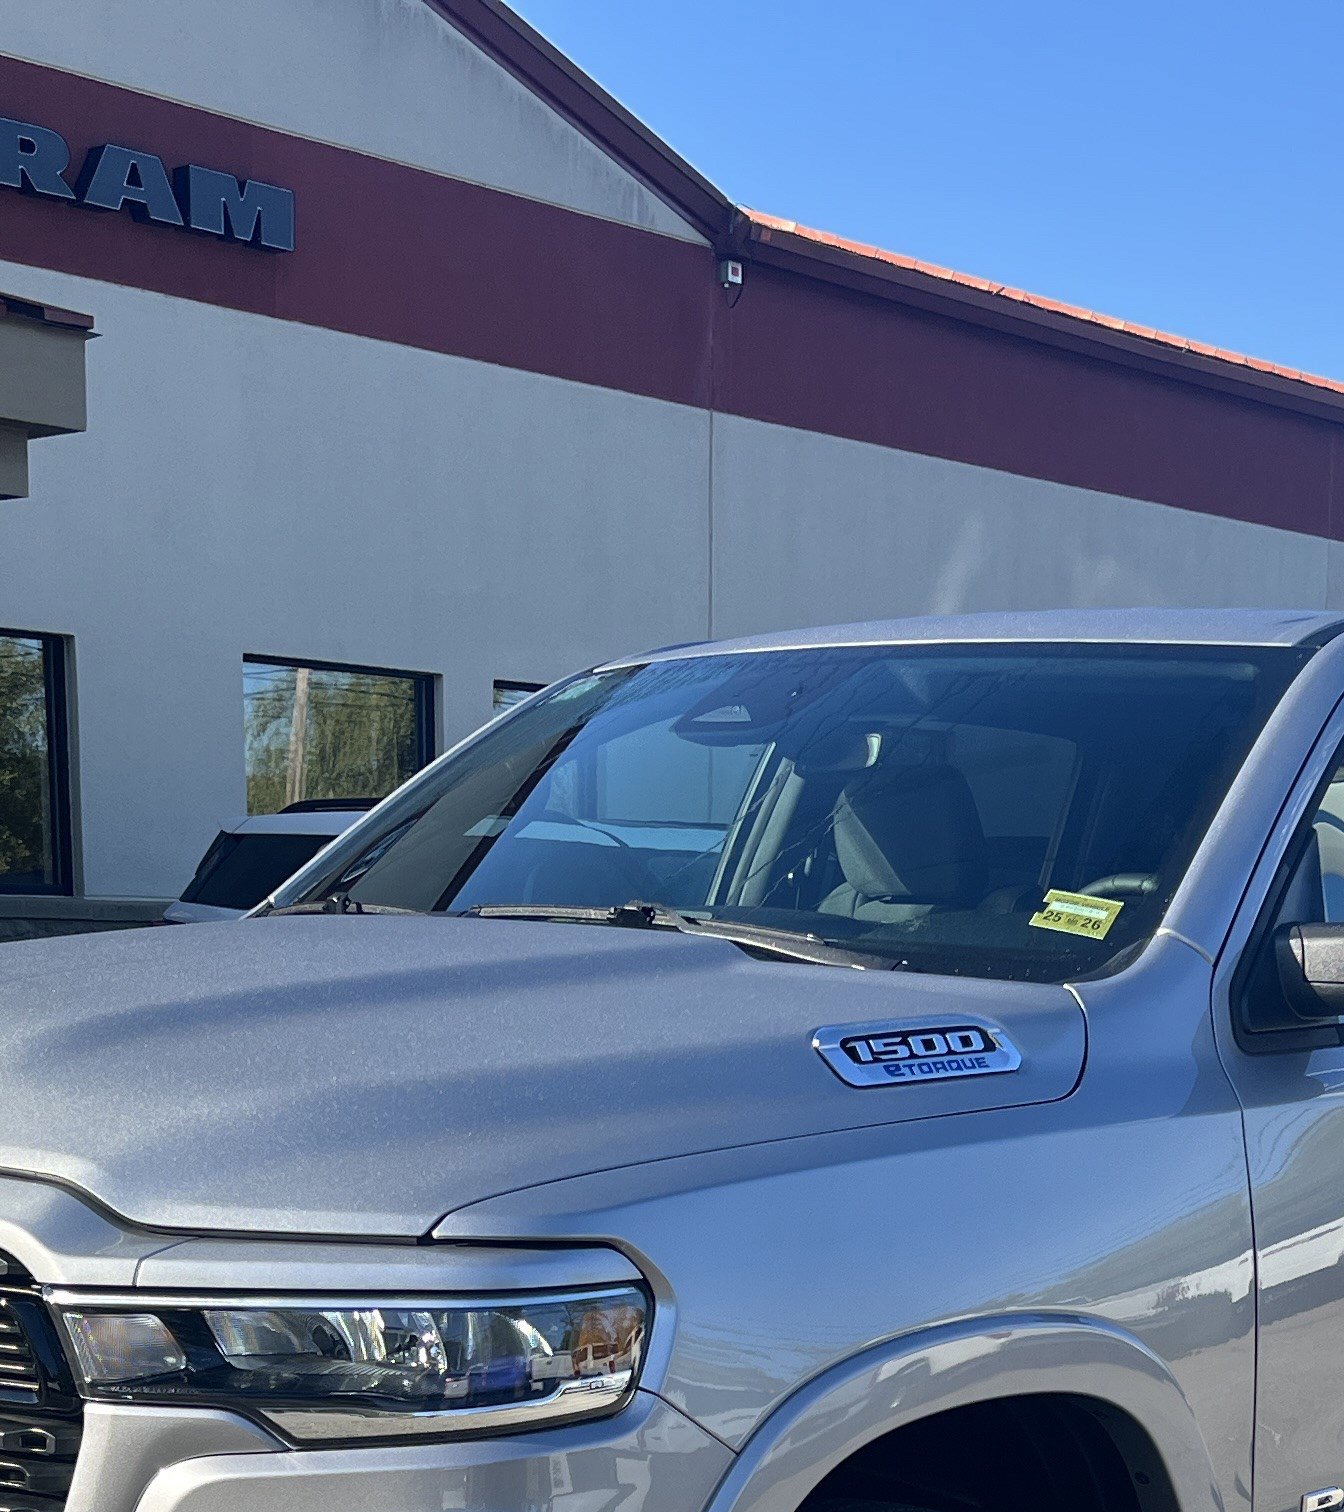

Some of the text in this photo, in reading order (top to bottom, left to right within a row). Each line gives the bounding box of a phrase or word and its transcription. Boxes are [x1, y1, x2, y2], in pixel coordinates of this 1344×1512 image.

[1042, 910, 1063, 923] 25
[1080, 917, 1103, 930] 26
[840, 1029, 987, 1064] 1500
